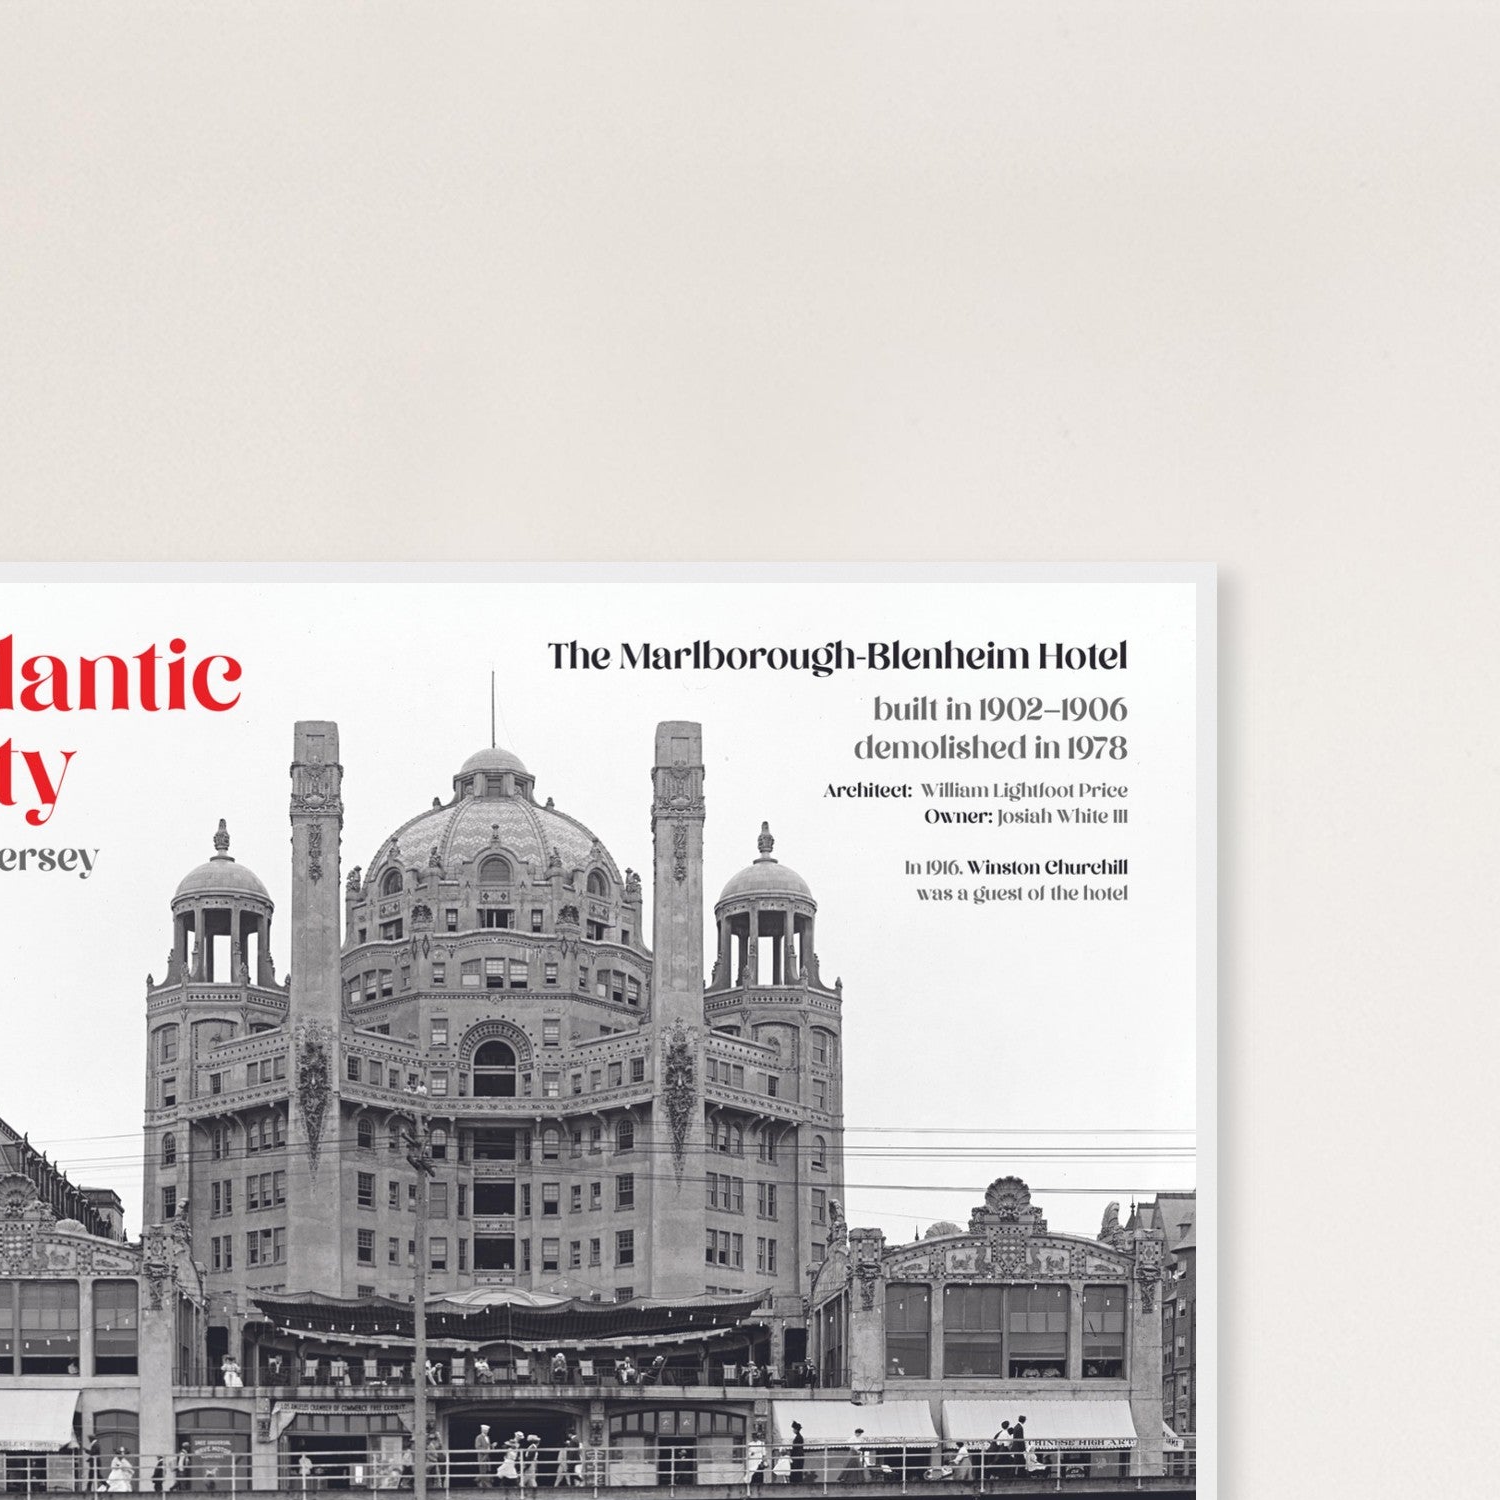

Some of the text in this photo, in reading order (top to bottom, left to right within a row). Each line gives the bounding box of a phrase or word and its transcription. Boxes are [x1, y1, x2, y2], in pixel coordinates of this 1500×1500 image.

[548, 640, 1128, 678] The Marlborough-Blenheim Hotel
[875, 696, 938, 722] built
[947, 697, 972, 721] in
[854, 735, 1128, 760] demolished in 1978
[824, 782, 1128, 802] Architect: William Lightfoot Price
[925, 808, 1128, 827] Owner: Josiah White III
[906, 861, 922, 875] In
[967, 860, 1041, 875] Winston
[1045, 859, 1128, 875] Churchill
[917, 885, 1128, 905] was a guest of the hotel
